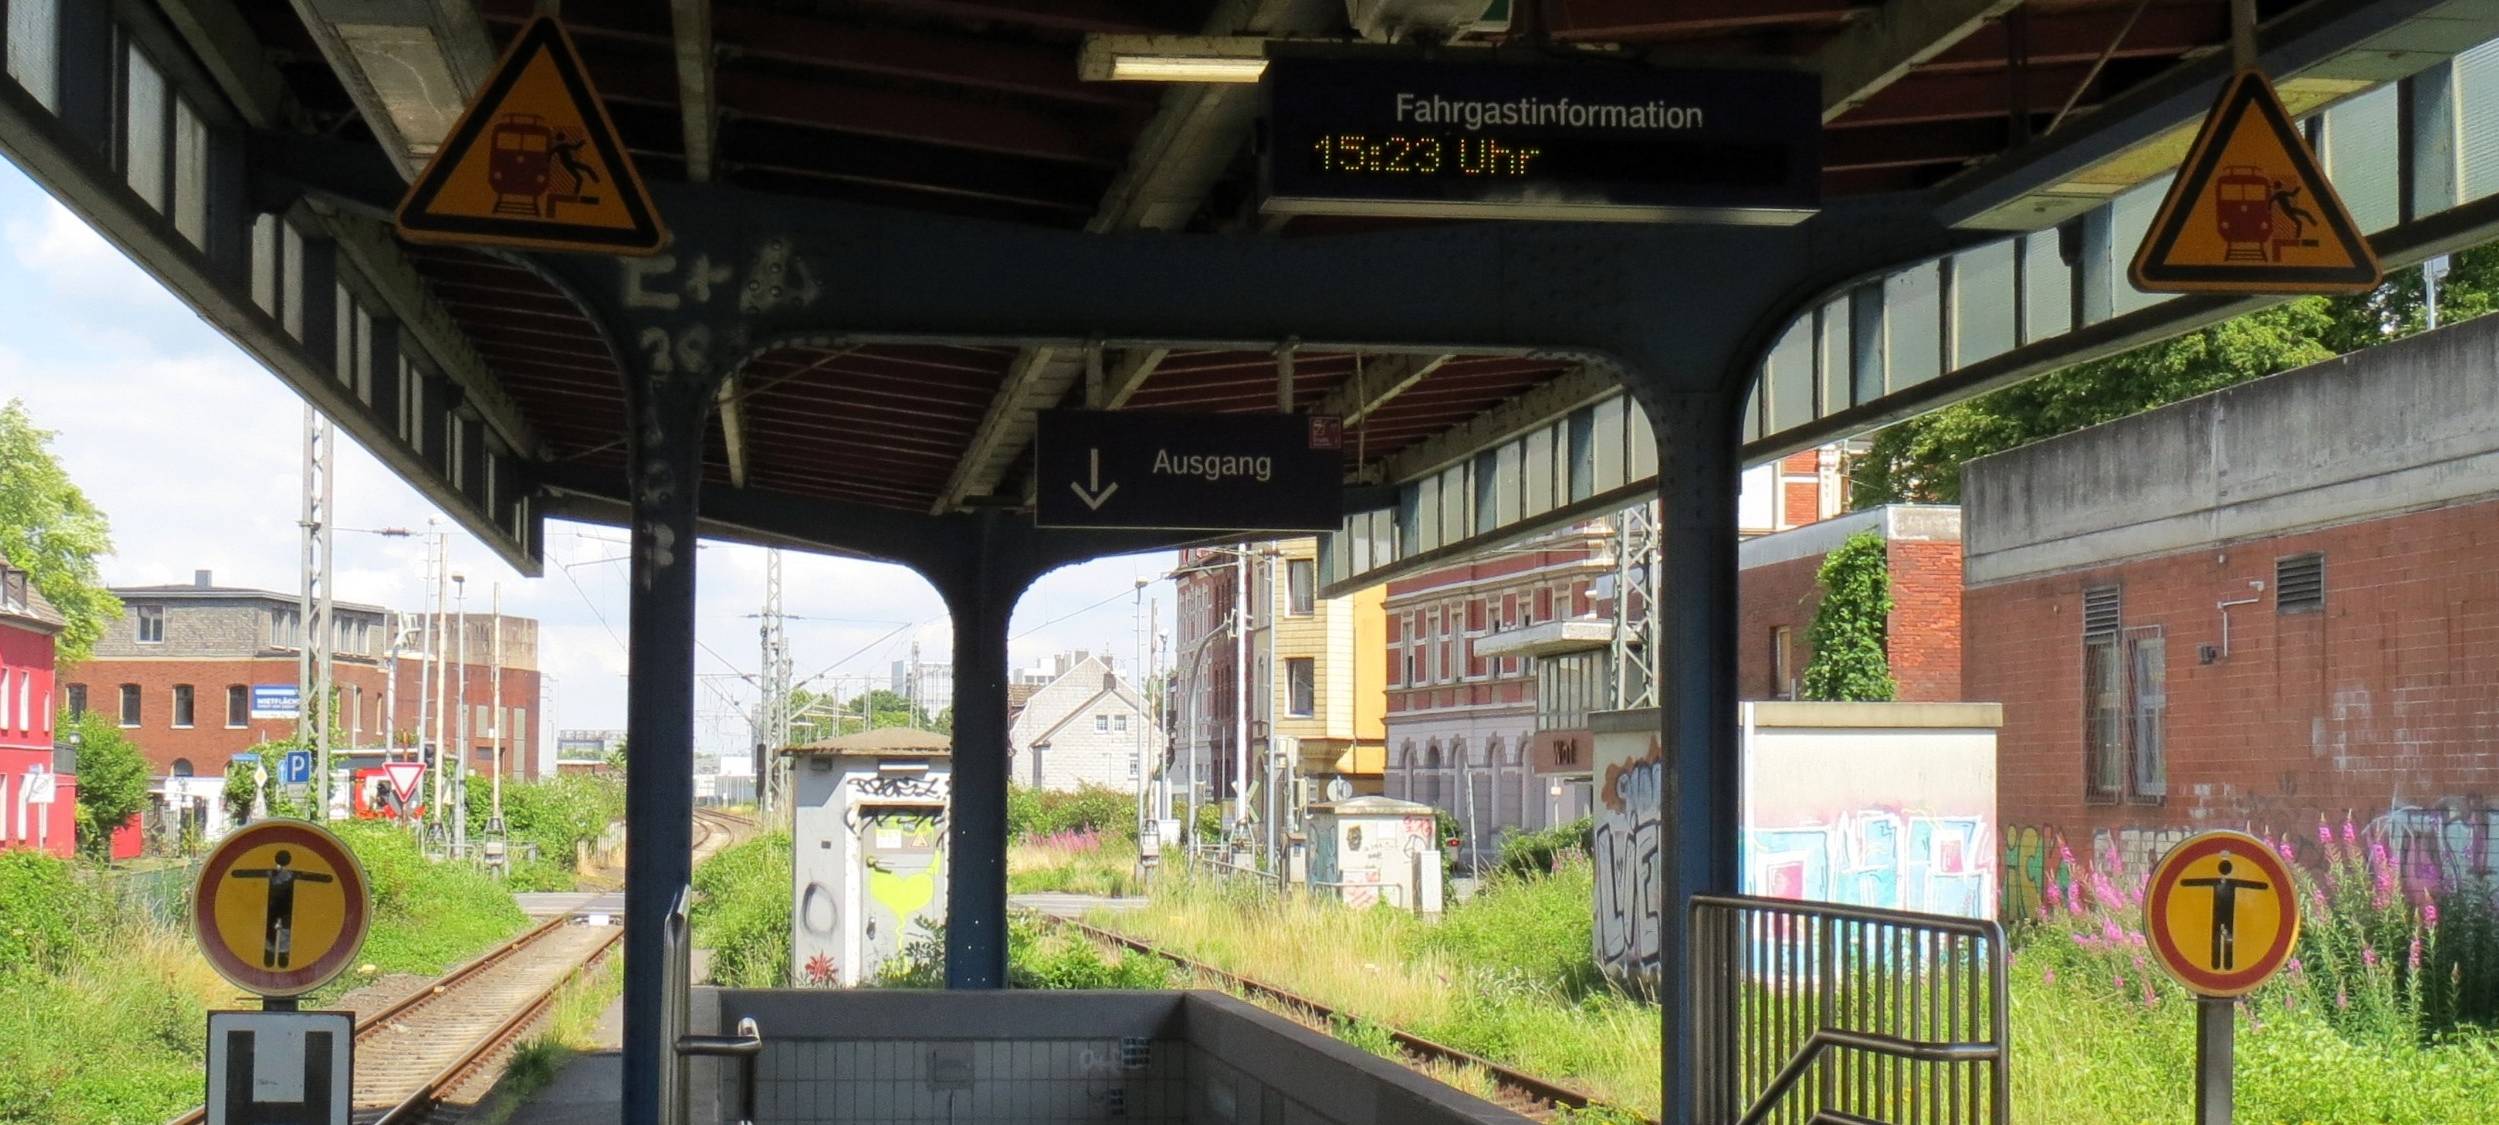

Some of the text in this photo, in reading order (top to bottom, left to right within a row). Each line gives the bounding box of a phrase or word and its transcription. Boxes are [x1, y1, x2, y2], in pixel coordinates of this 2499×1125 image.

[1396, 92, 1703, 130] Fahrgastinformation
[1312, 135, 1541, 175] 15:23 Uhr
[1152, 448, 1271, 482] Ausgang
[292, 754, 305, 781] P
